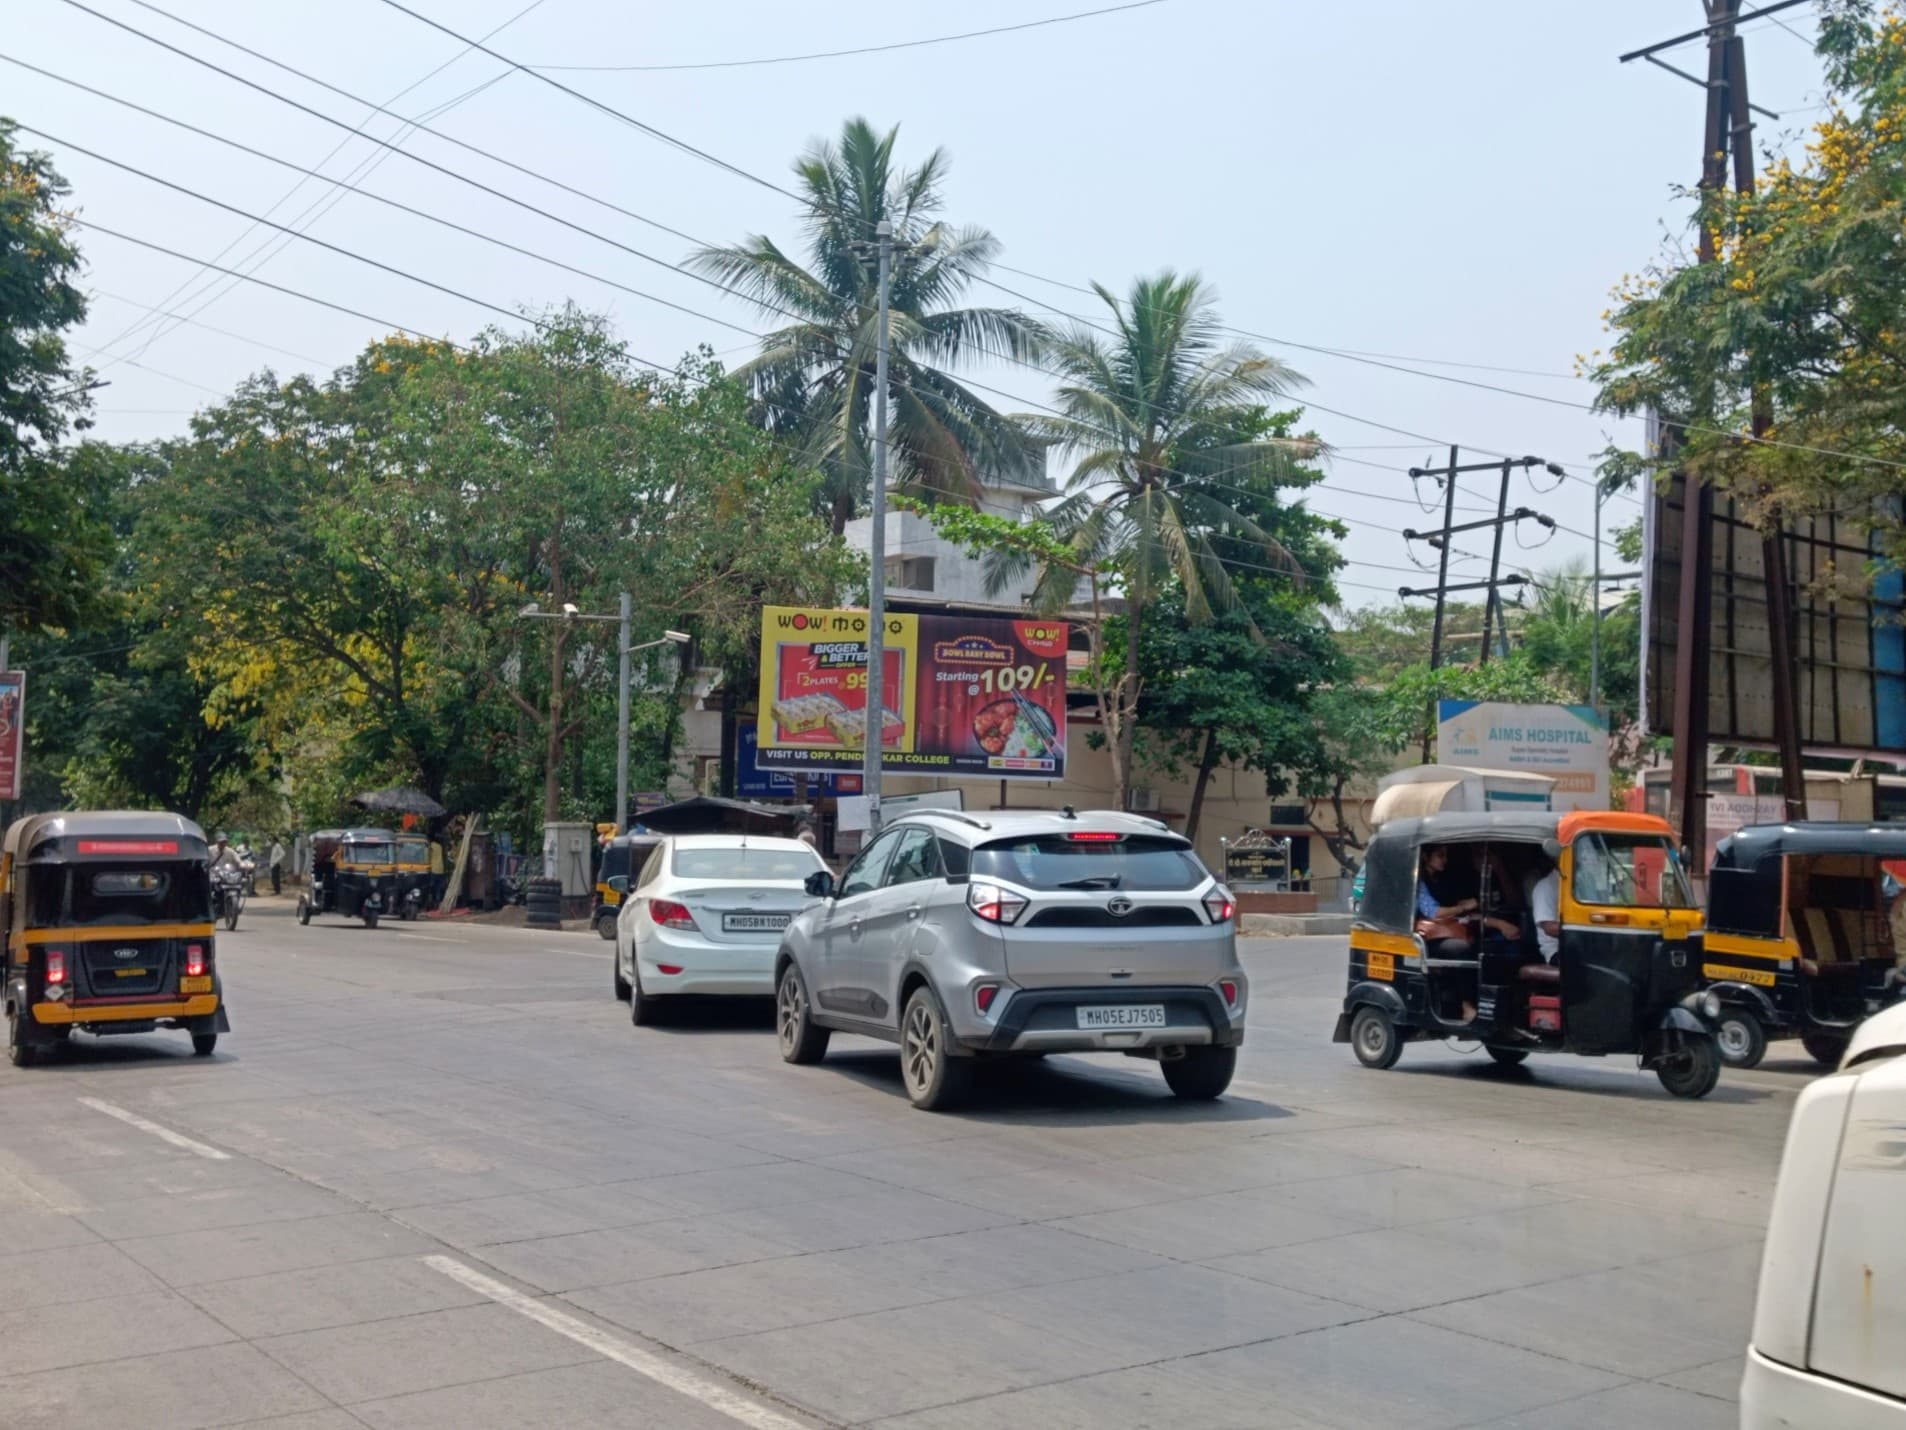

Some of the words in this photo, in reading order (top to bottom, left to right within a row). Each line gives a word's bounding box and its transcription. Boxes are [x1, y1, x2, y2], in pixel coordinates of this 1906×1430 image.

[814, 643, 860, 654] BIGGER
[936, 671, 979, 682] Starting
[980, 662, 1054, 693] 109/-
[1488, 728, 1523, 742] AIMS
[1527, 729, 1592, 744] HOSPITAL
[766, 750, 792, 758] VISIT
[794, 751, 808, 760] US
[810, 752, 833, 760] OPP.
[905, 754, 950, 764] COLLEGE
[1086, 1008, 1164, 1025] MH05EJ7505
